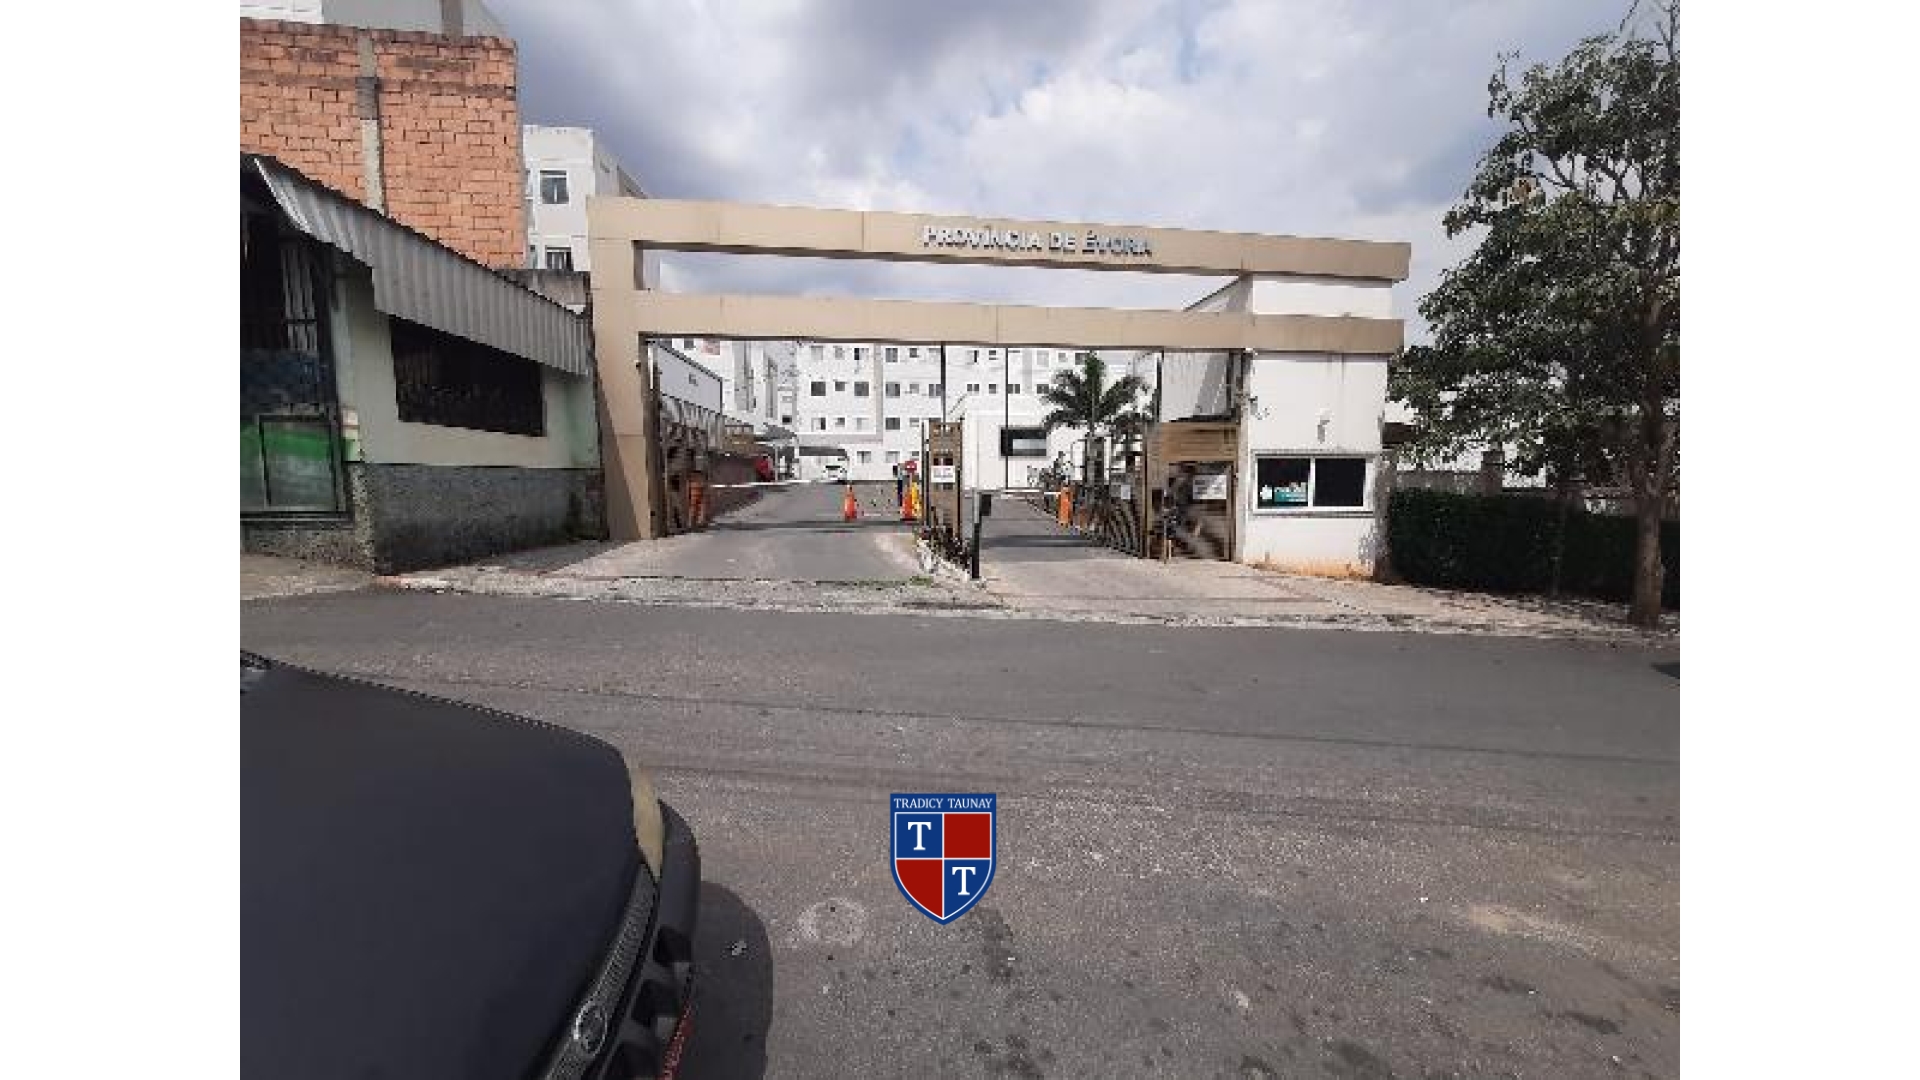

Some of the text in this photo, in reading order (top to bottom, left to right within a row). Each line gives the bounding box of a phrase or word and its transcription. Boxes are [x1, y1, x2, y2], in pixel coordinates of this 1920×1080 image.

[923, 225, 1152, 255] PROVÍNCIA DE ÉVORA
